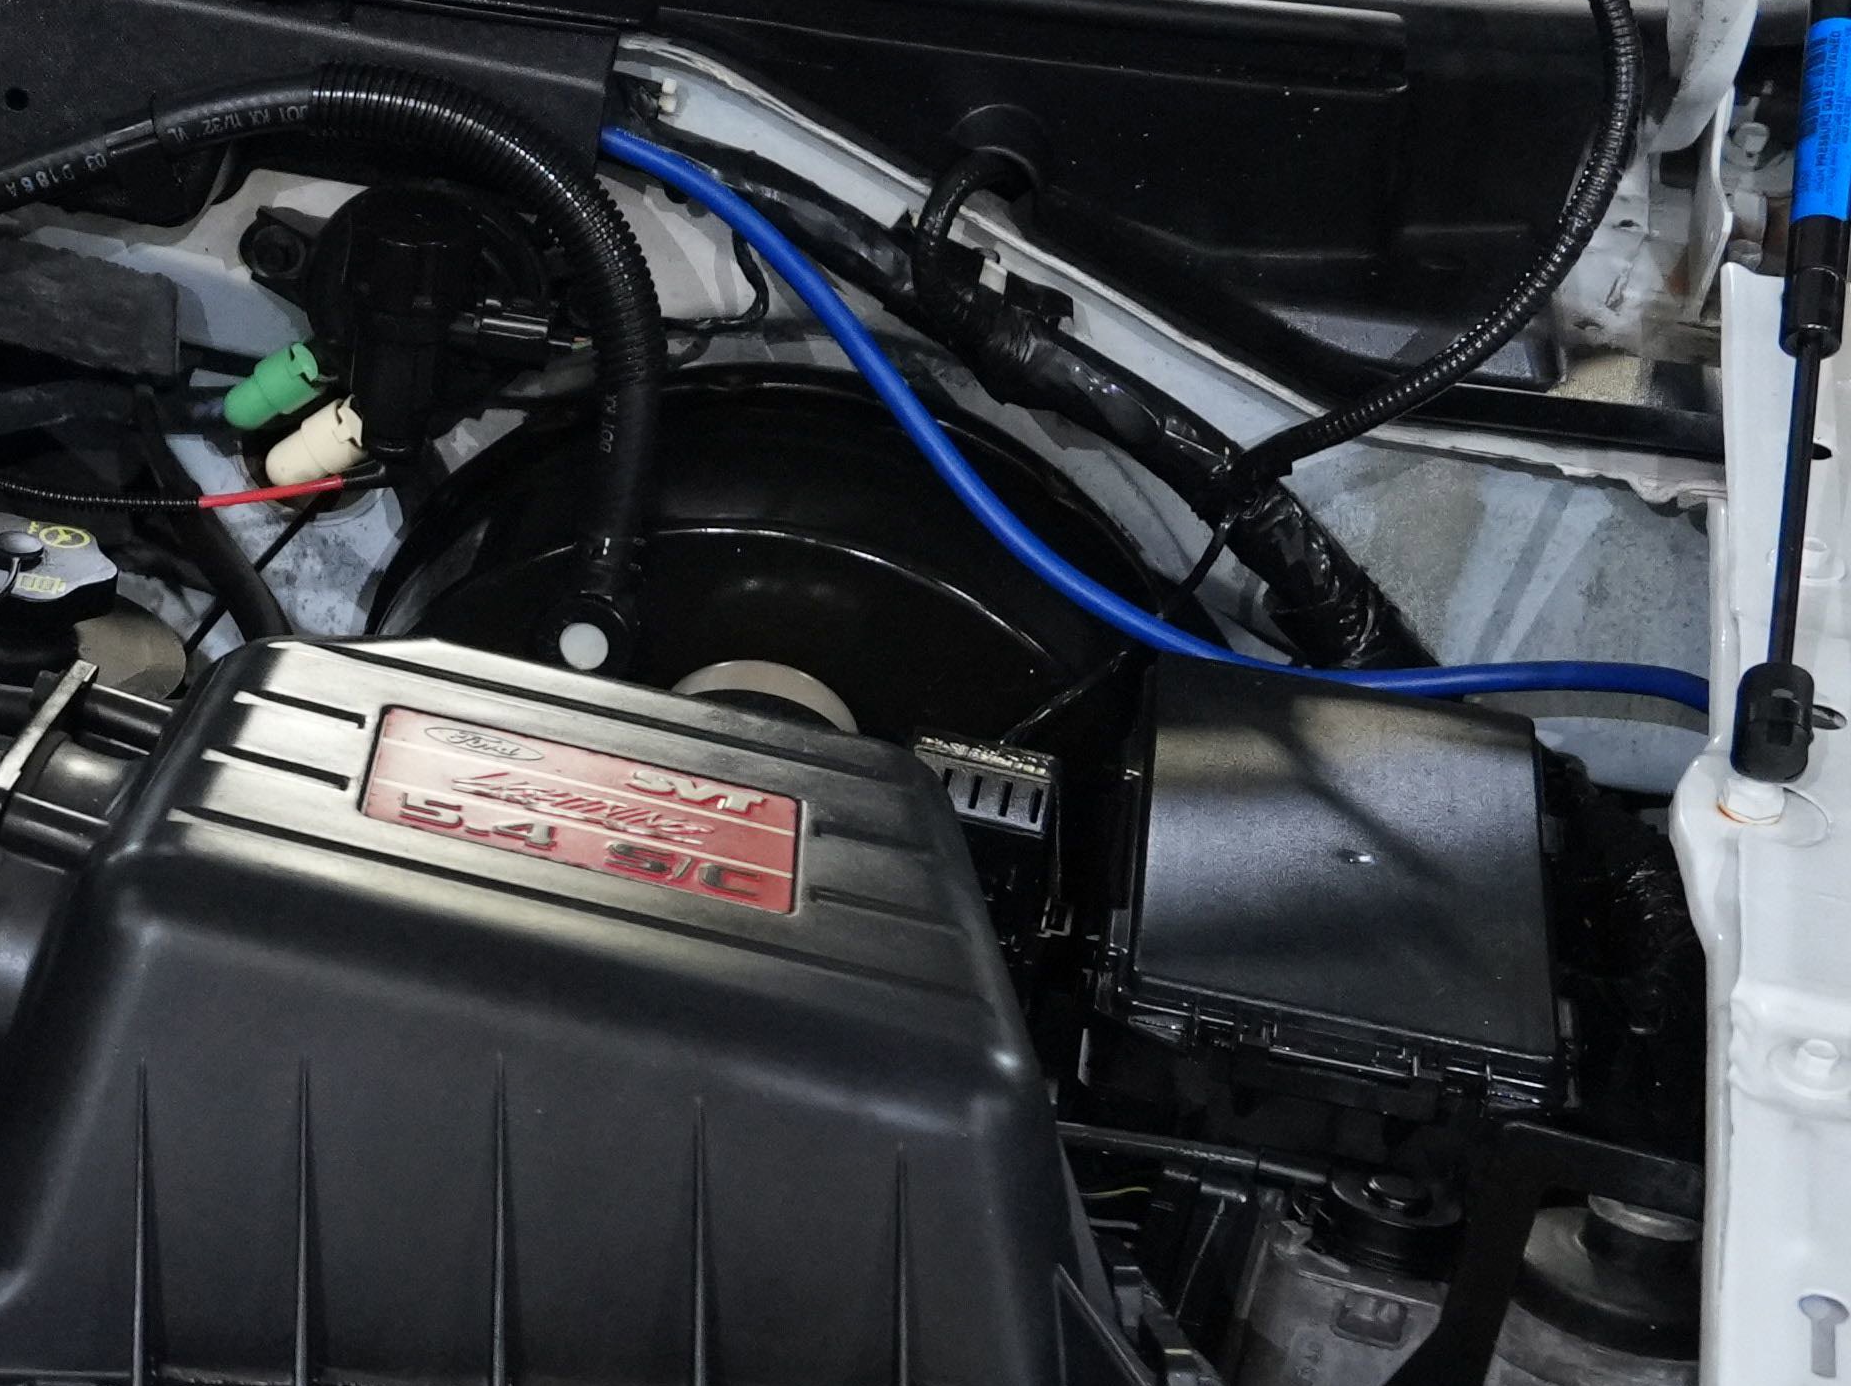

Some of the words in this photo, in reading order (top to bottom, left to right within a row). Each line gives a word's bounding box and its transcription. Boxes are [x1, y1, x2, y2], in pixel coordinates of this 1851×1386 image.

[457, 729, 523, 759] Ford
[626, 767, 768, 816] SVT
[399, 790, 558, 853] 5.4
[604, 840, 765, 902] S/C
